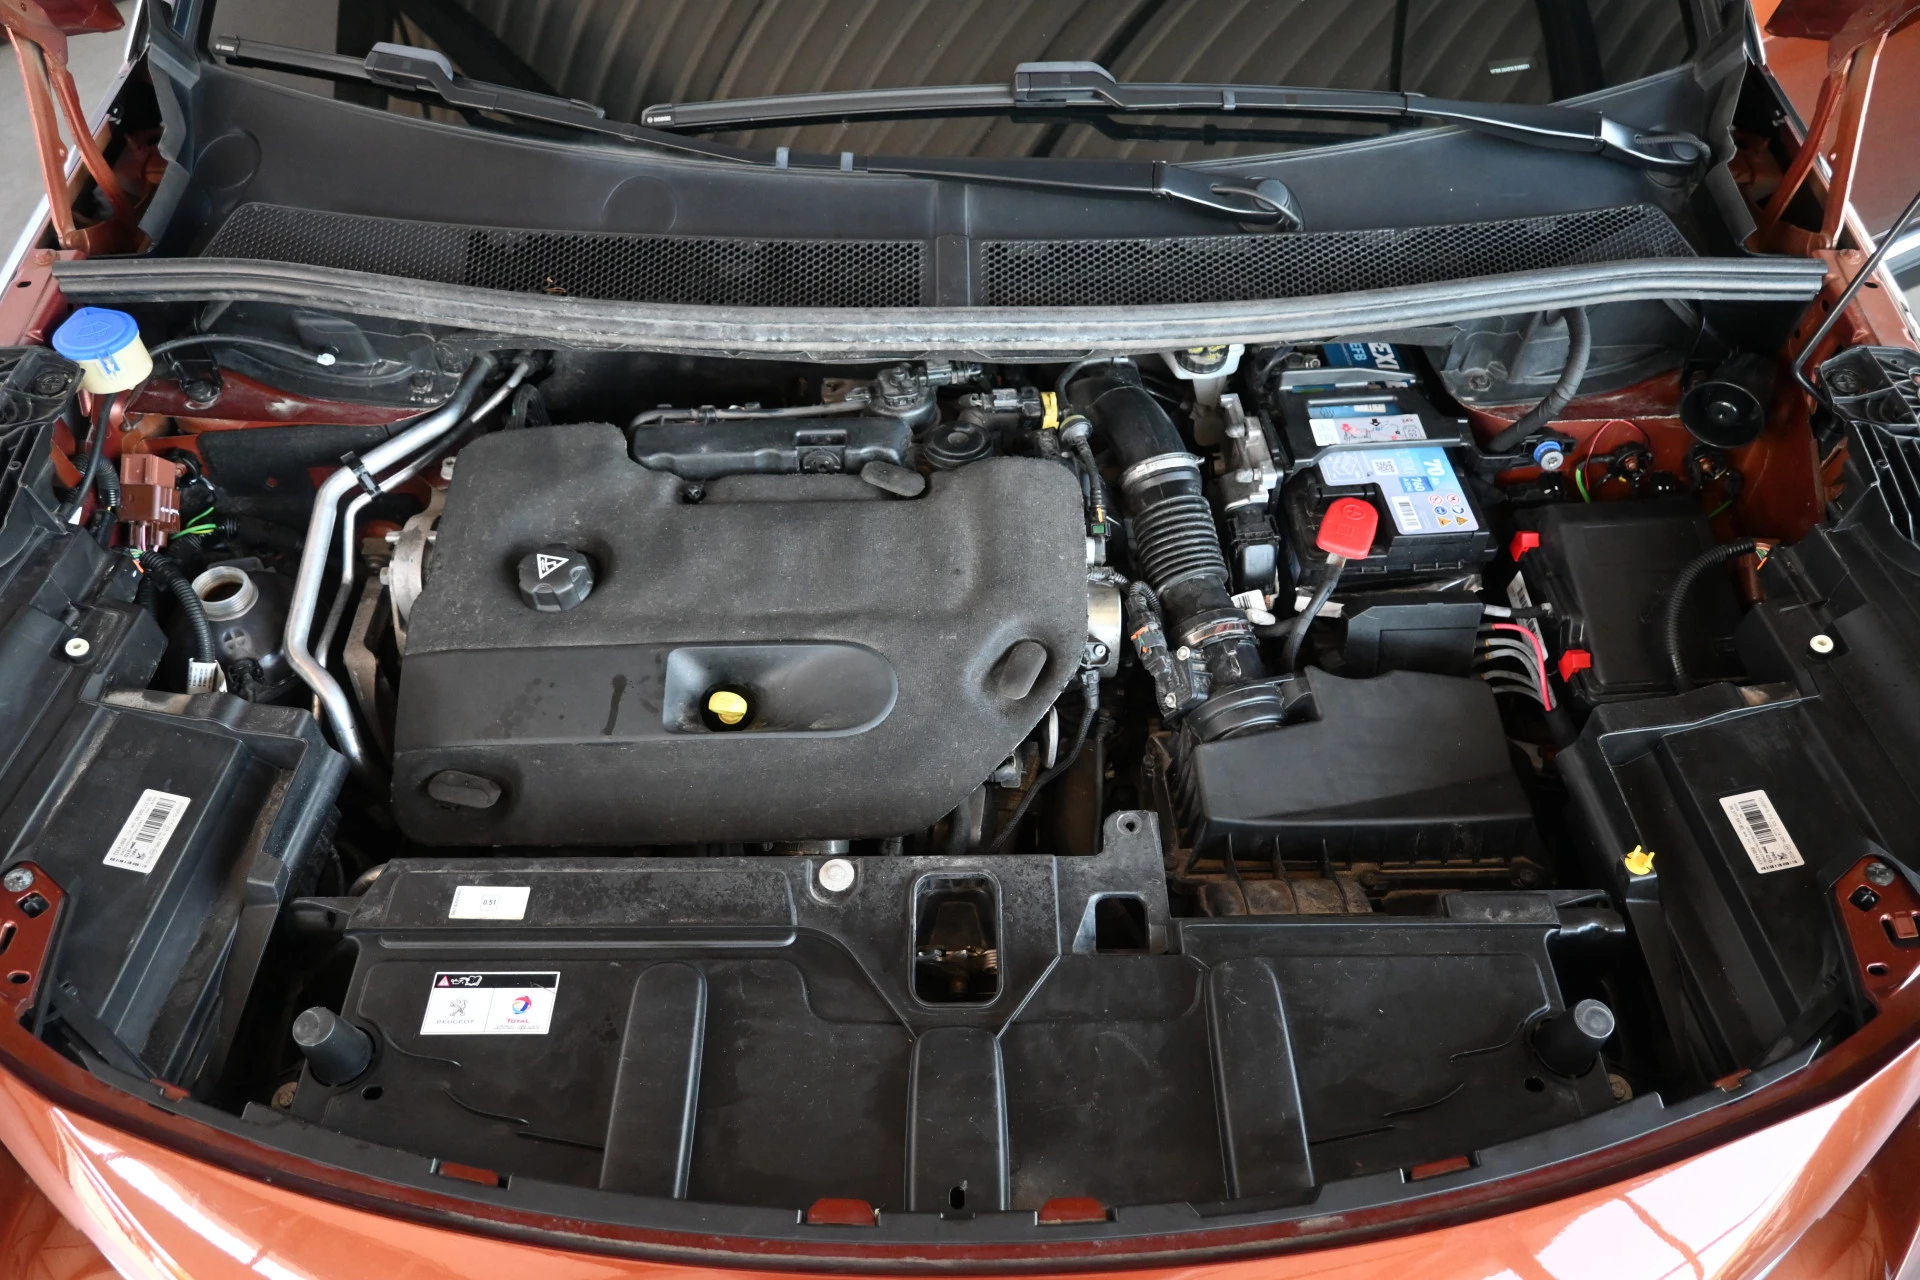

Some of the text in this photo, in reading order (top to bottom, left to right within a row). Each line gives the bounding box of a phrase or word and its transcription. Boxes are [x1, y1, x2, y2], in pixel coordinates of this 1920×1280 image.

[1349, 343, 1368, 361] EFB
[1423, 458, 1446, 476] 70
[1411, 477, 1425, 491] 760
